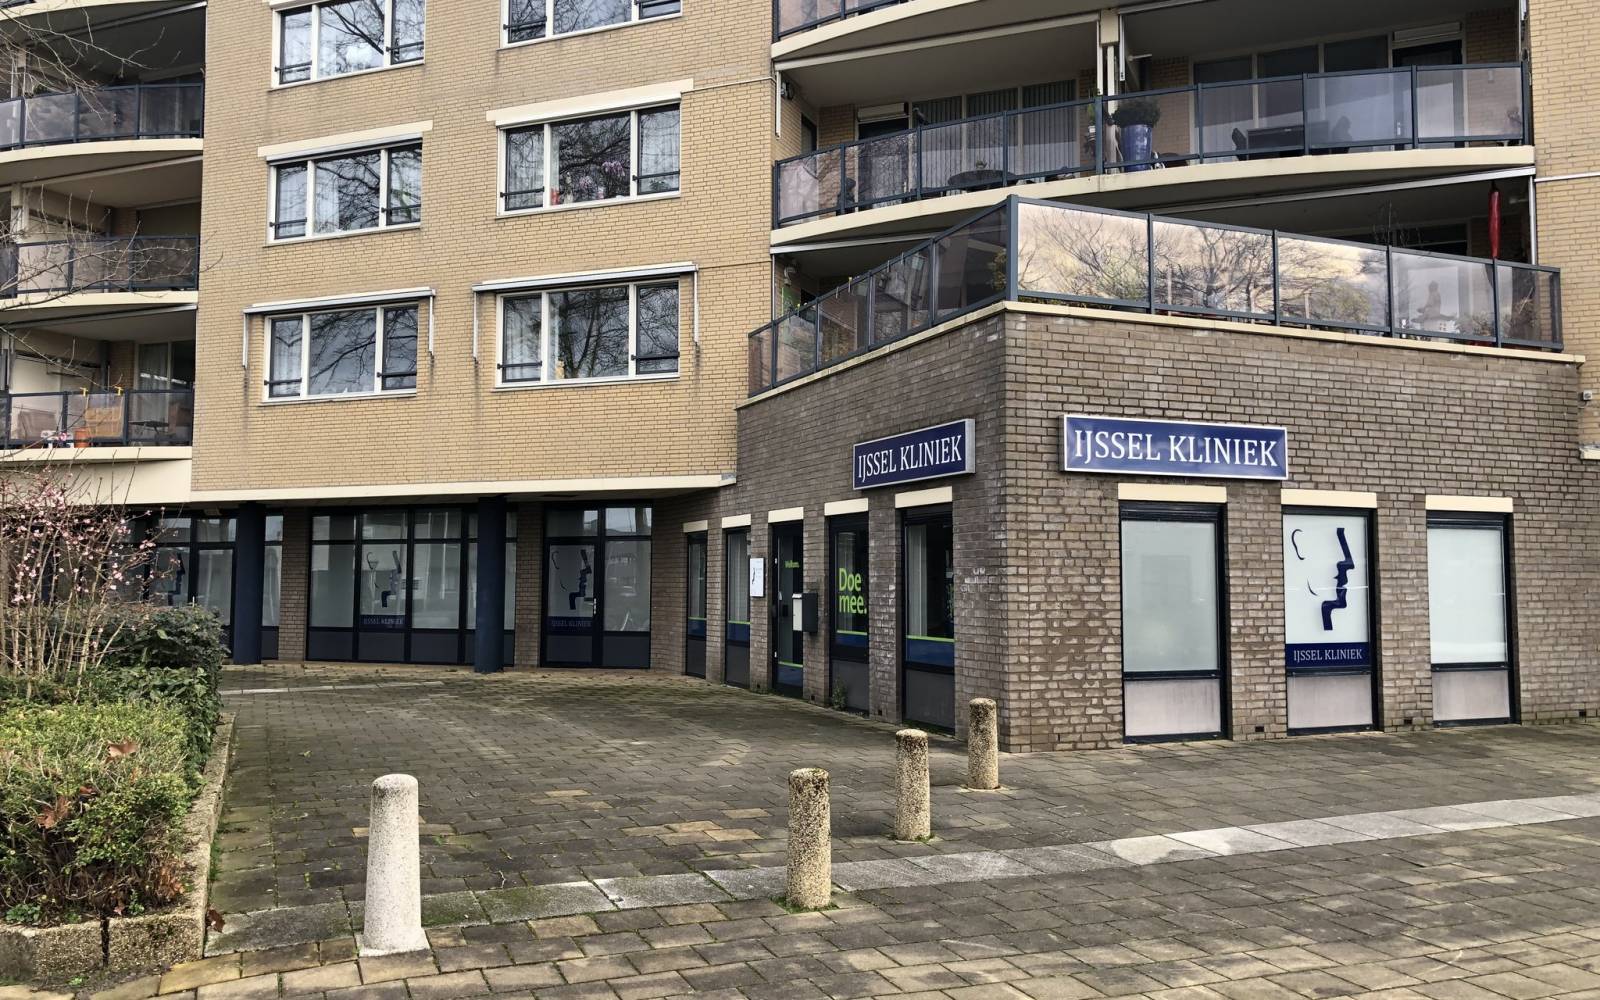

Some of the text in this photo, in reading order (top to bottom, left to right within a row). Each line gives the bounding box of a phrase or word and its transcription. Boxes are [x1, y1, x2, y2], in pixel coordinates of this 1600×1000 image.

[858, 434, 962, 483] IJSSEL KLINIEK
[1075, 430, 1278, 467] IJSSEL KLINIEK
[838, 567, 862, 592] Doe
[838, 594, 867, 615] mee.
[1293, 648, 1363, 663] IJSSEL KLINIEK
